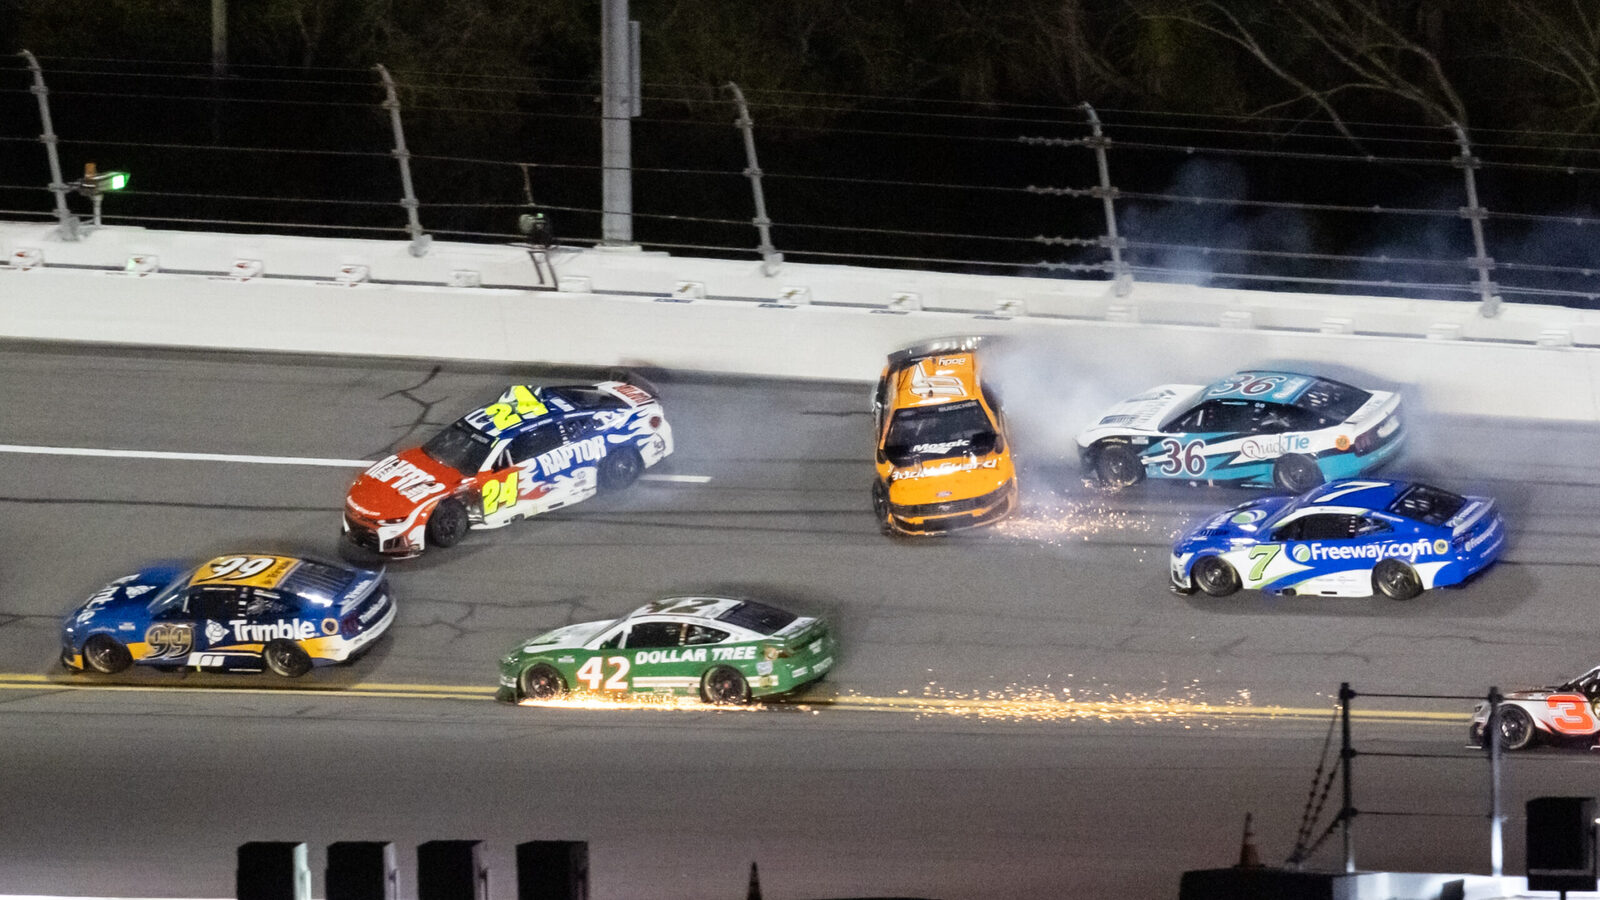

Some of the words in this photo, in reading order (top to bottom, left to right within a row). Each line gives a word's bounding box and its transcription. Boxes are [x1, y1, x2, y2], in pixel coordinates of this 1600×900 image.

[1206, 374, 1288, 397] 36
[485, 385, 549, 431] 24
[537, 435, 607, 477] RAPTOR
[912, 439, 970, 452] Mosaic
[1160, 438, 1207, 477] 36
[482, 471, 520, 516] 24
[1313, 480, 1391, 503] 7
[1248, 544, 1281, 581] 7
[1311, 538, 1433, 562] Freeway.com
[196, 557, 276, 583] 99
[145, 623, 194, 661] 99
[229, 617, 316, 641] Trimble
[635, 650, 707, 665] DOLLAR
[712, 646, 757, 661] TREE
[576, 656, 631, 691] 42
[1546, 694, 1595, 735] 3
